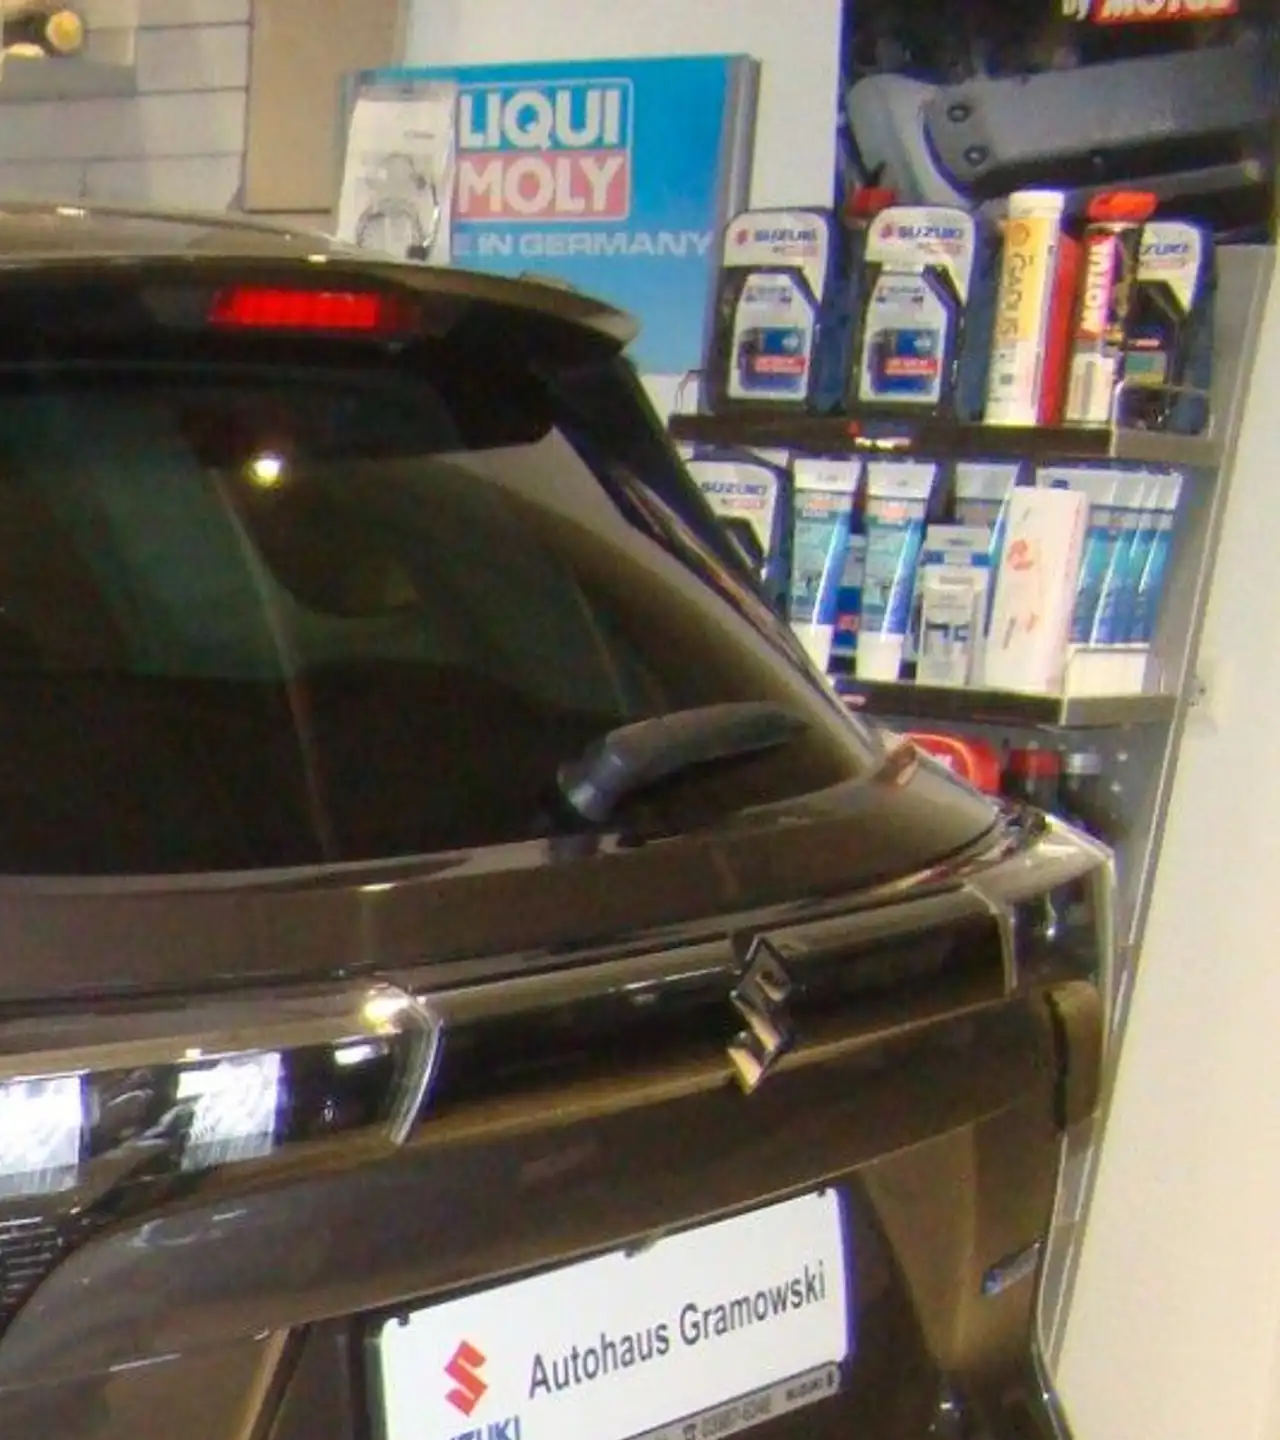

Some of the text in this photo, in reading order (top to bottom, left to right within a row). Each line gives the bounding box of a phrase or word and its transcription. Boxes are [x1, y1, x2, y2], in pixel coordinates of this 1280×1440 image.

[459, 88, 624, 150] LIQUI
[458, 155, 627, 214] MOLY
[477, 233, 513, 257] IN
[518, 230, 714, 258] GERMANY
[528, 1258, 826, 1399] Autohaus Gramowski
